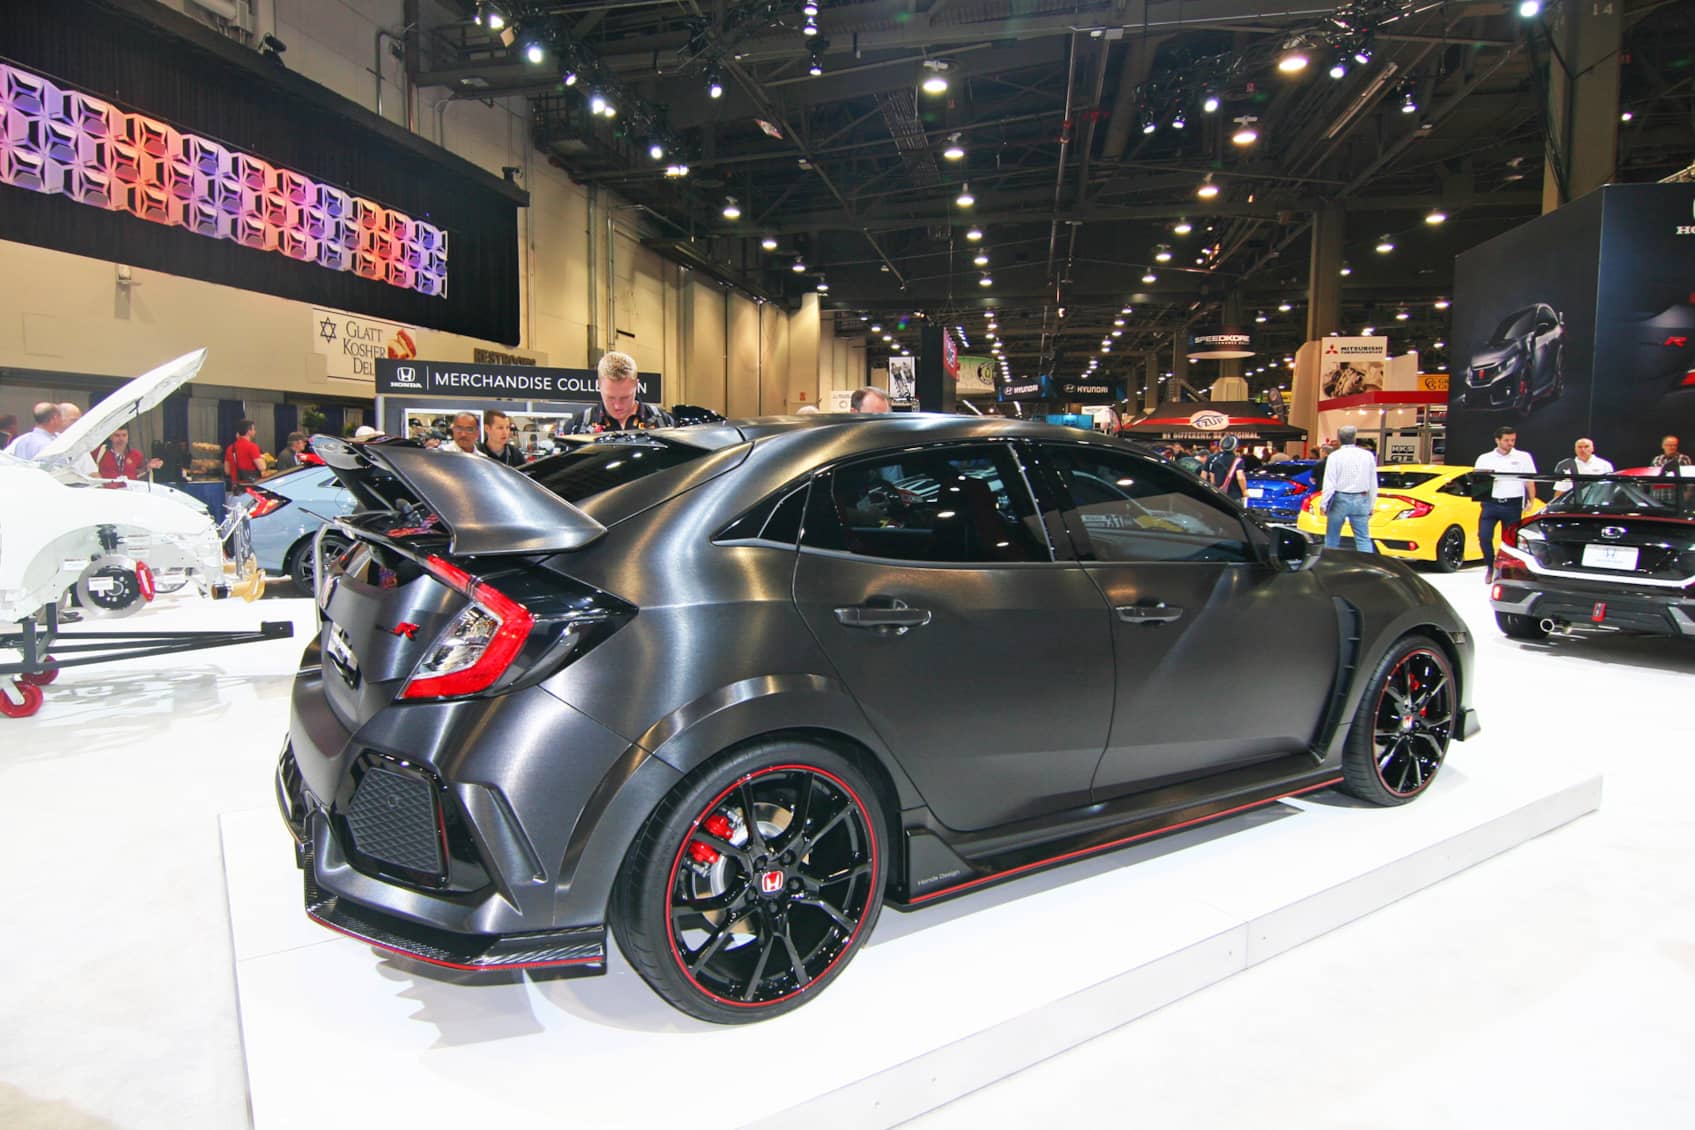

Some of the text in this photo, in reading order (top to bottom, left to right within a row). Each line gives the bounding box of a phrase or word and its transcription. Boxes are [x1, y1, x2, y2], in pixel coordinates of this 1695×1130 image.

[345, 320, 383, 342] GLATT
[343, 337, 386, 359] KOSHER
[352, 357, 375, 376] DEL
[435, 372, 647, 394] MERCHANDISE COLLEN
[1014, 384, 1039, 394] HYUNDAI
